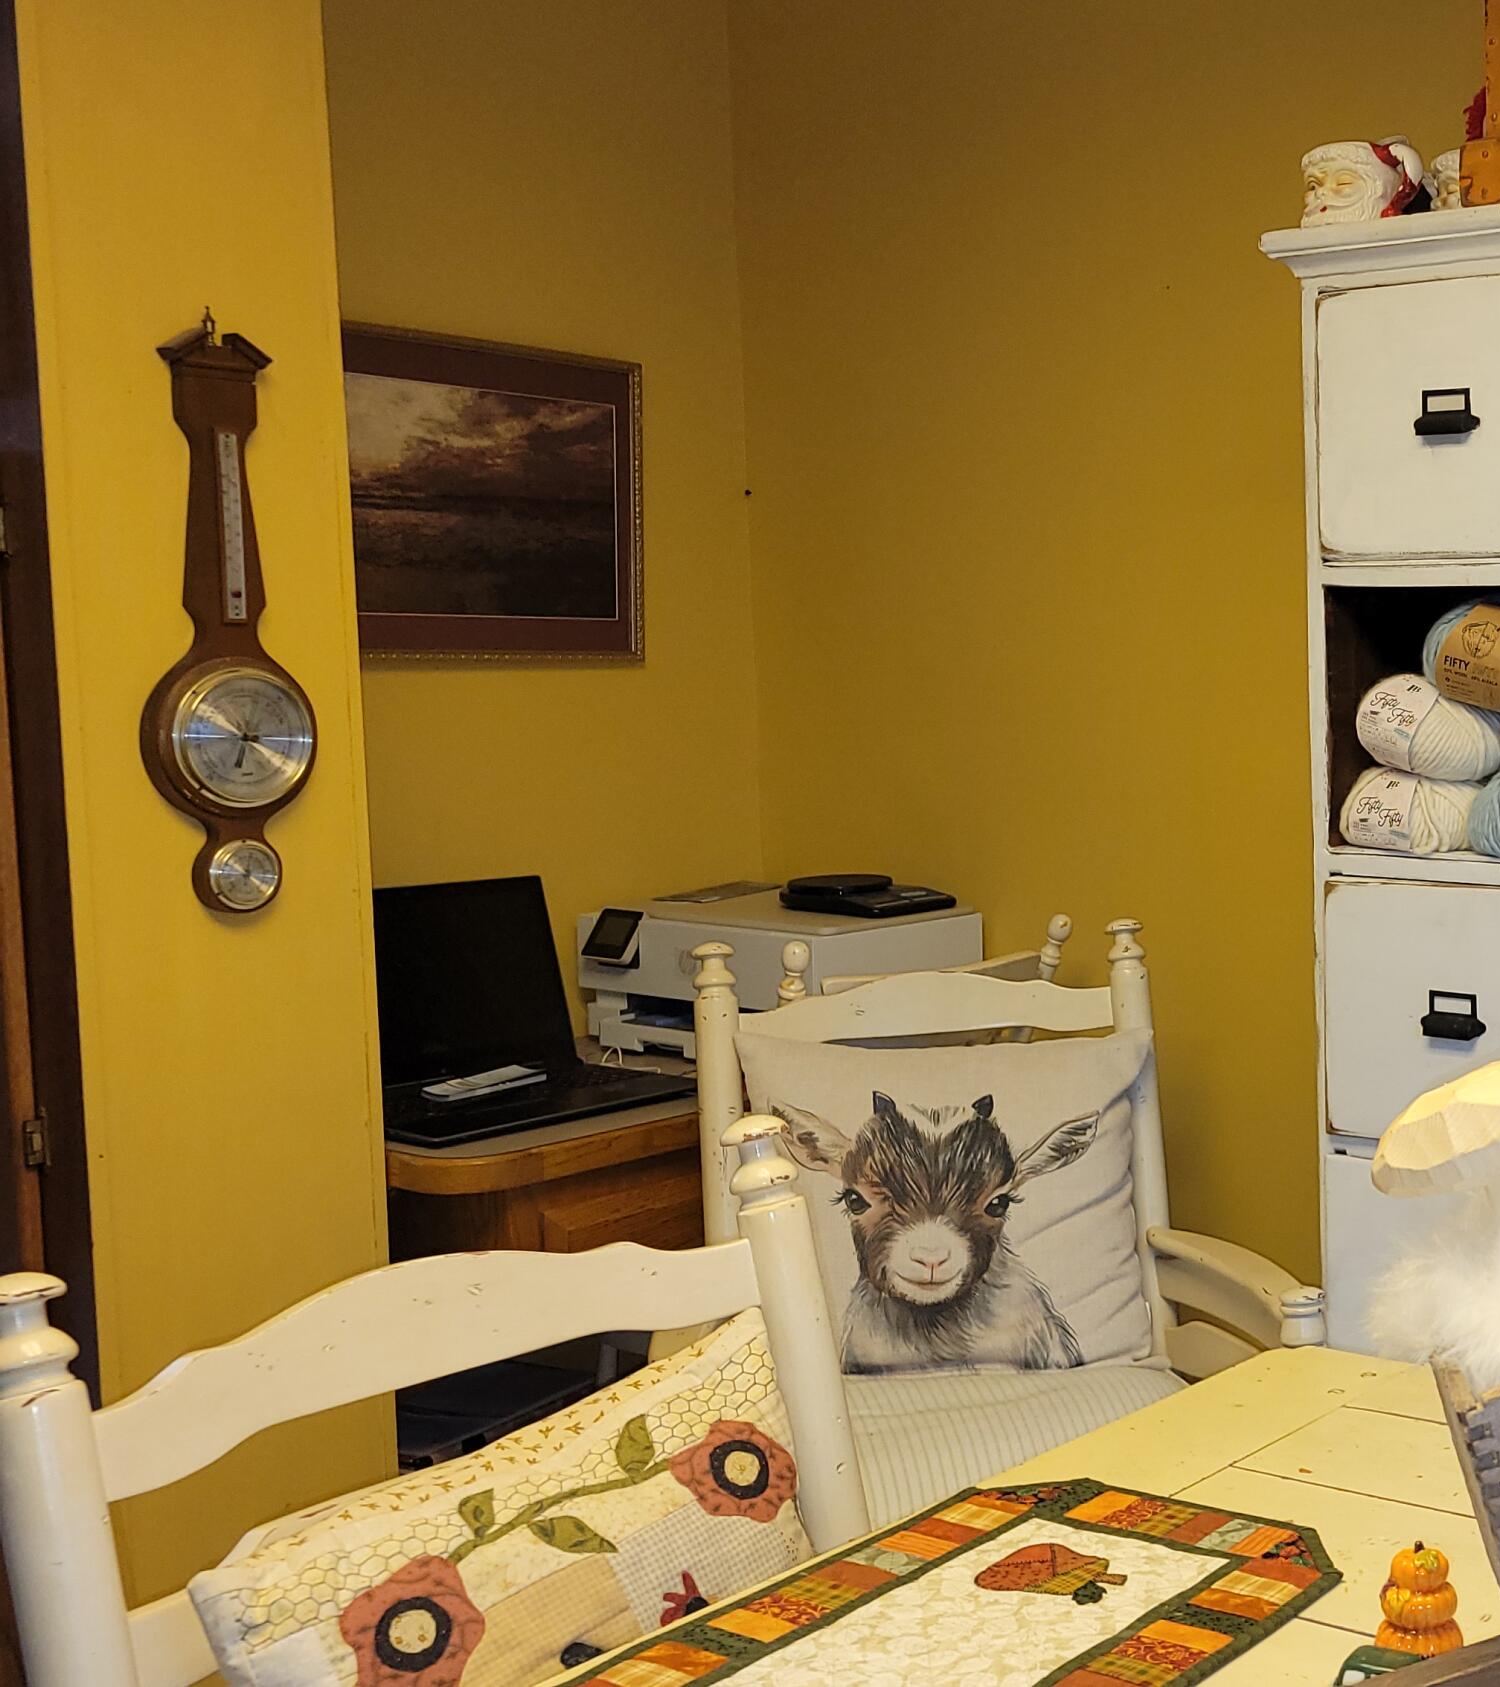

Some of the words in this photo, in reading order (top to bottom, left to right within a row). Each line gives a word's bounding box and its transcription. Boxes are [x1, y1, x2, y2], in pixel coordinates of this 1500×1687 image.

[1443, 655, 1470, 671] FIFTY
[1370, 692, 1400, 711] Fifty
[1387, 707, 1417, 727] Fifty
[1356, 796, 1383, 815] Fifty
[1377, 808, 1403, 828] Fifty
